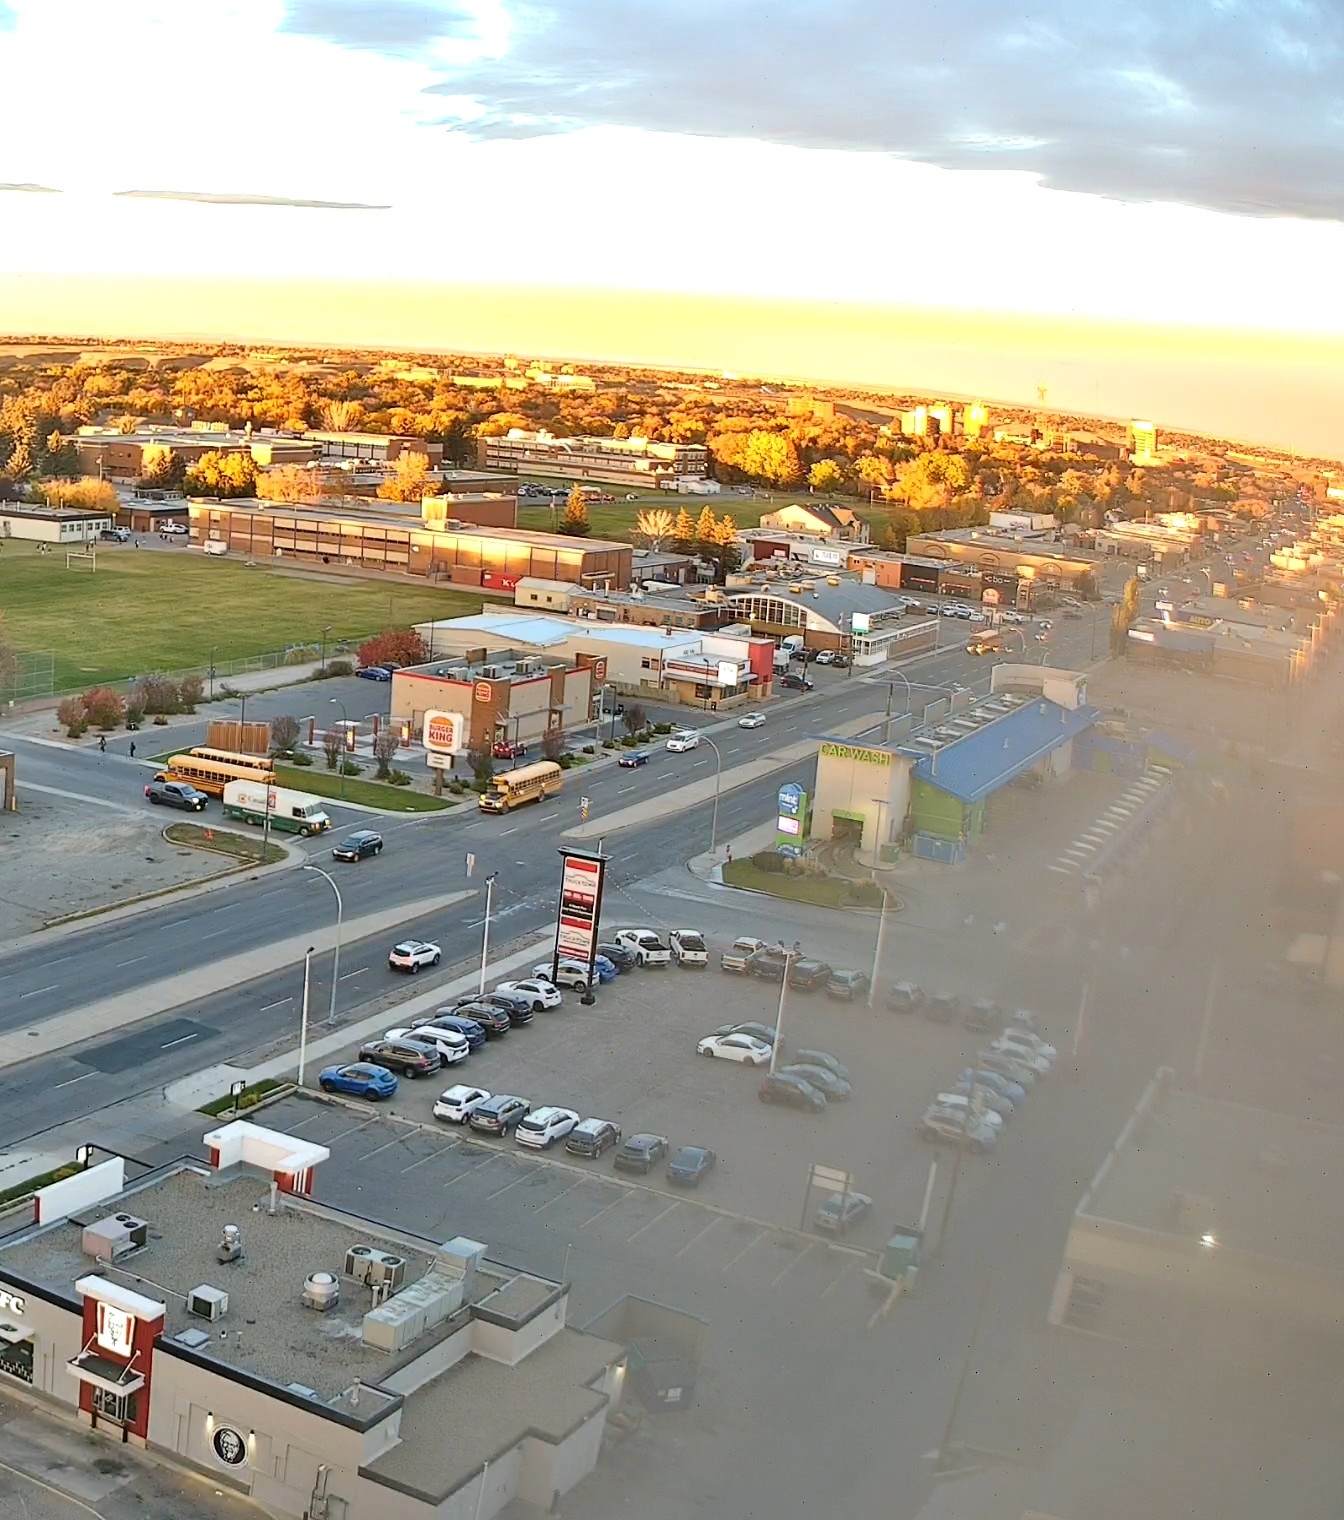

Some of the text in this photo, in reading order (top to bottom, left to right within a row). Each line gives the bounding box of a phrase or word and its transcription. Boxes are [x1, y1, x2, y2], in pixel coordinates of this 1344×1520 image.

[429, 723, 453, 733] BURGER
[429, 730, 453, 742] KING
[820, 743, 892, 767] CAR WASH
